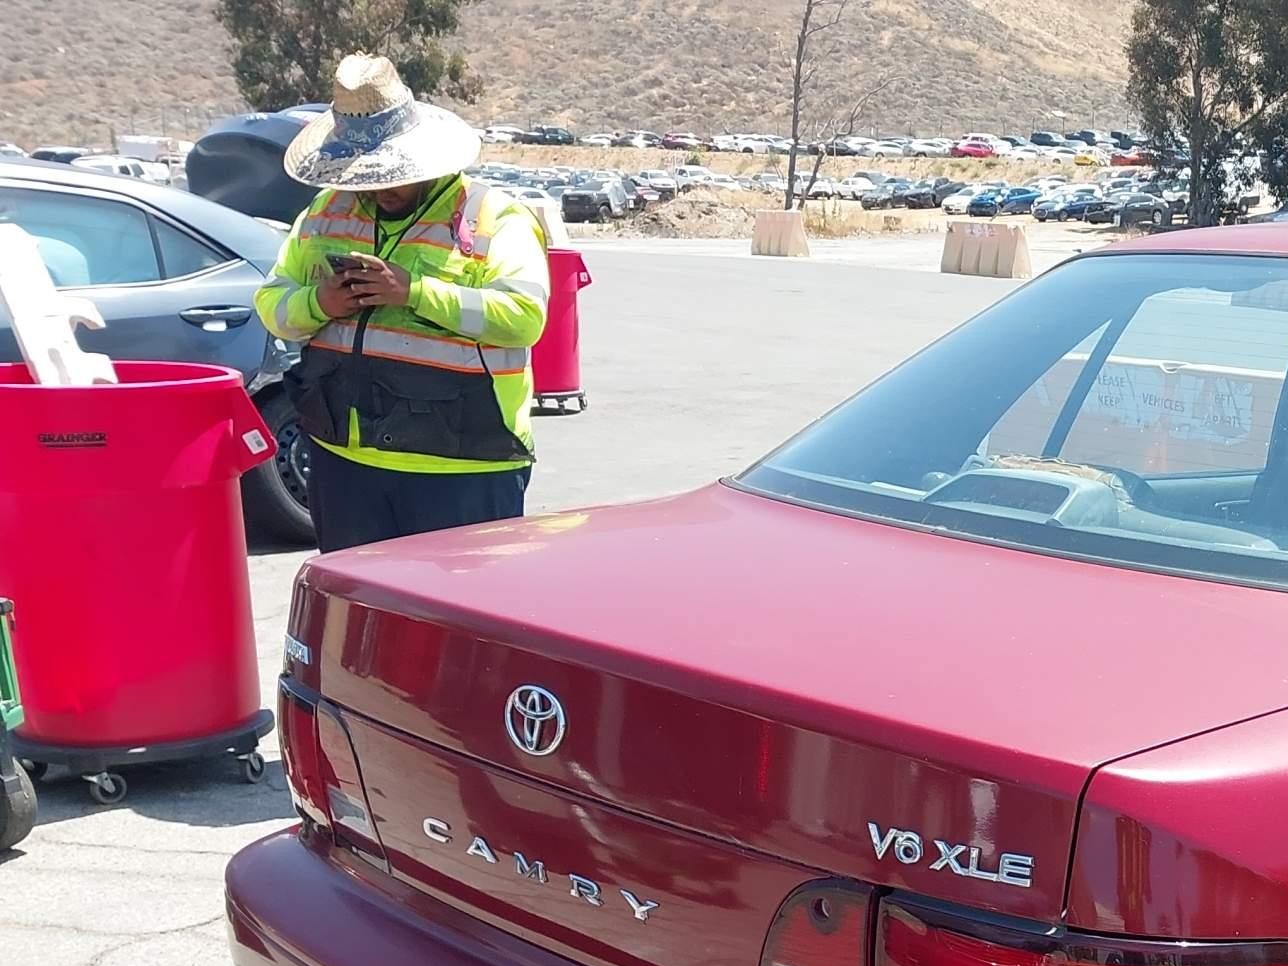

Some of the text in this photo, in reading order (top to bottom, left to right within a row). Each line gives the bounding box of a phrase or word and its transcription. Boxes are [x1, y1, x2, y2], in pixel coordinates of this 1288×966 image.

[1097, 374, 1127, 388] LEASE
[1141, 392, 1186, 413] VEHICLES
[38, 432, 106, 444] GRAINGER
[867, 821, 1034, 888] V6 XLE
[422, 817, 660, 923] CAMRY
